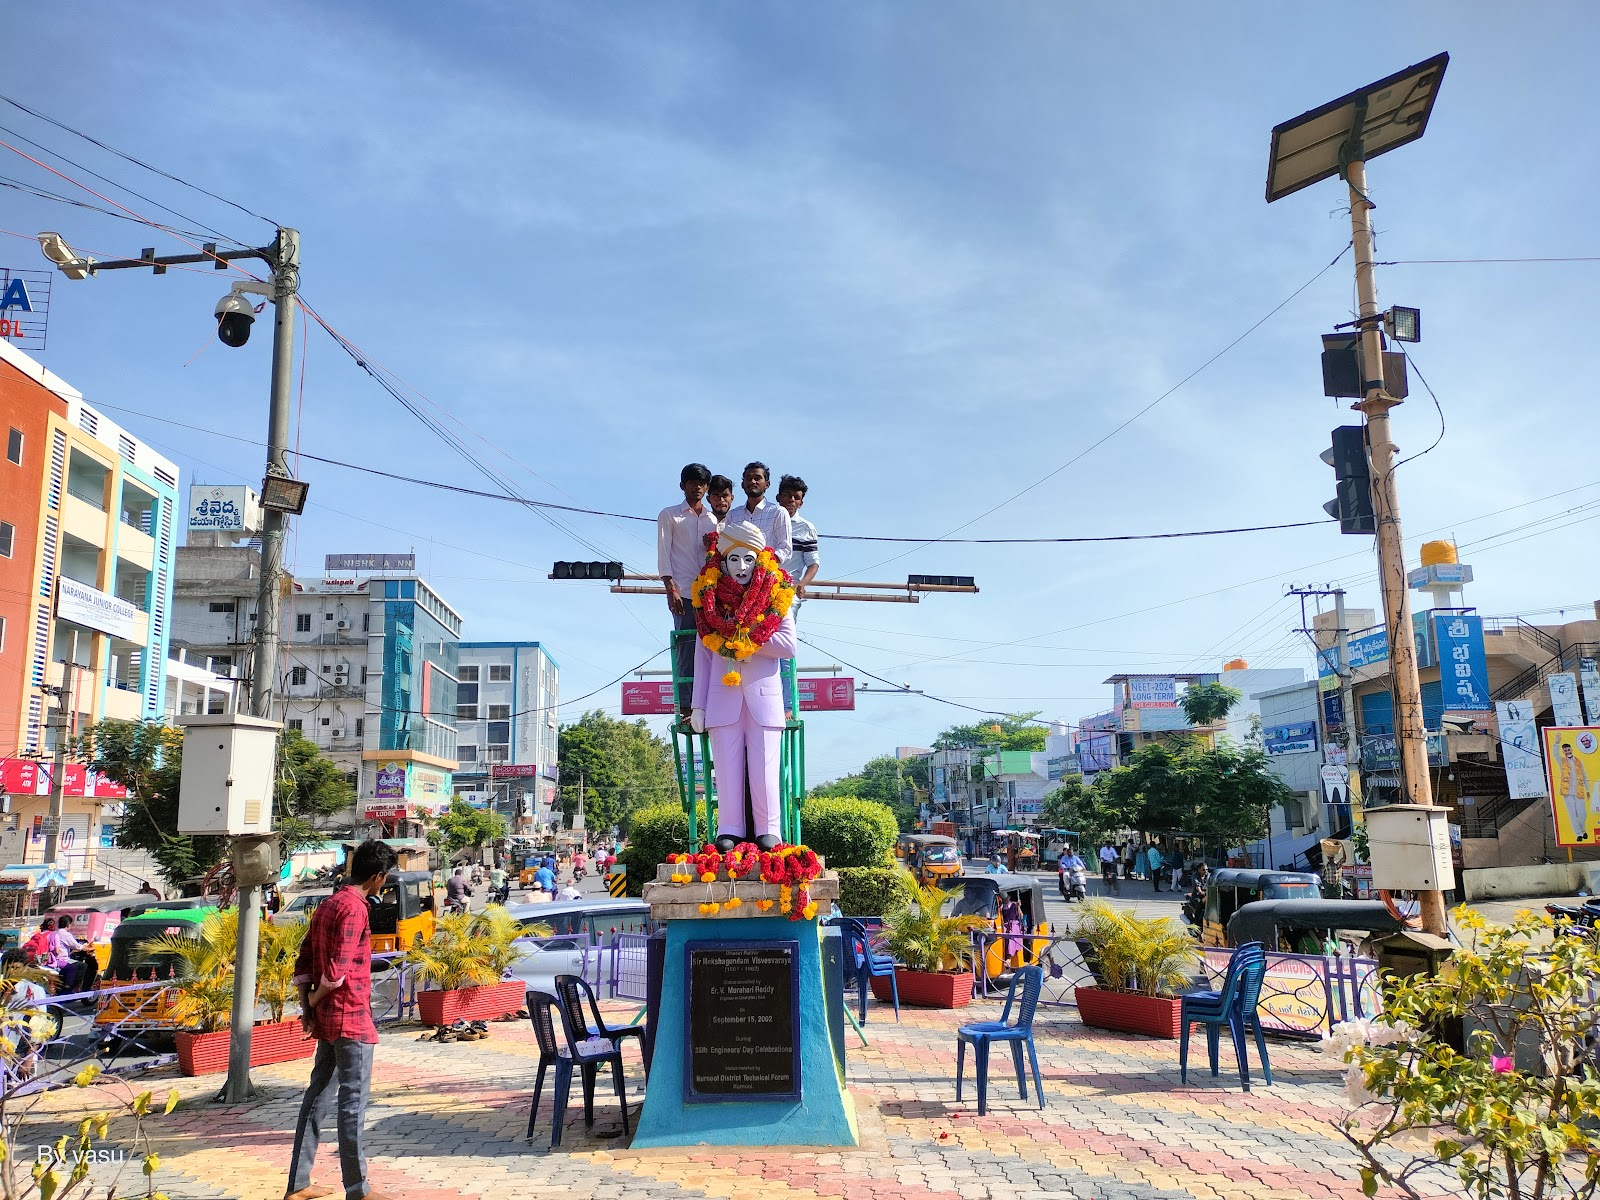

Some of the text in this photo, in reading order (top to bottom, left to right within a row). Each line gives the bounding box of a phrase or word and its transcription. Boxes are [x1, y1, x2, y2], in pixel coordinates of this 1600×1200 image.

[0, 278, 33, 312] A
[62, 584, 92, 602] NARAYANA
[93, 596, 112, 611] JUNIOR
[112, 604, 134, 620] COLLEGE
[702, 957, 749, 966] Mokshagundam
[752, 957, 792, 966] Visvesvaraya
[755, 986, 774, 994] Reddy
[713, 1016, 746, 1024] September
